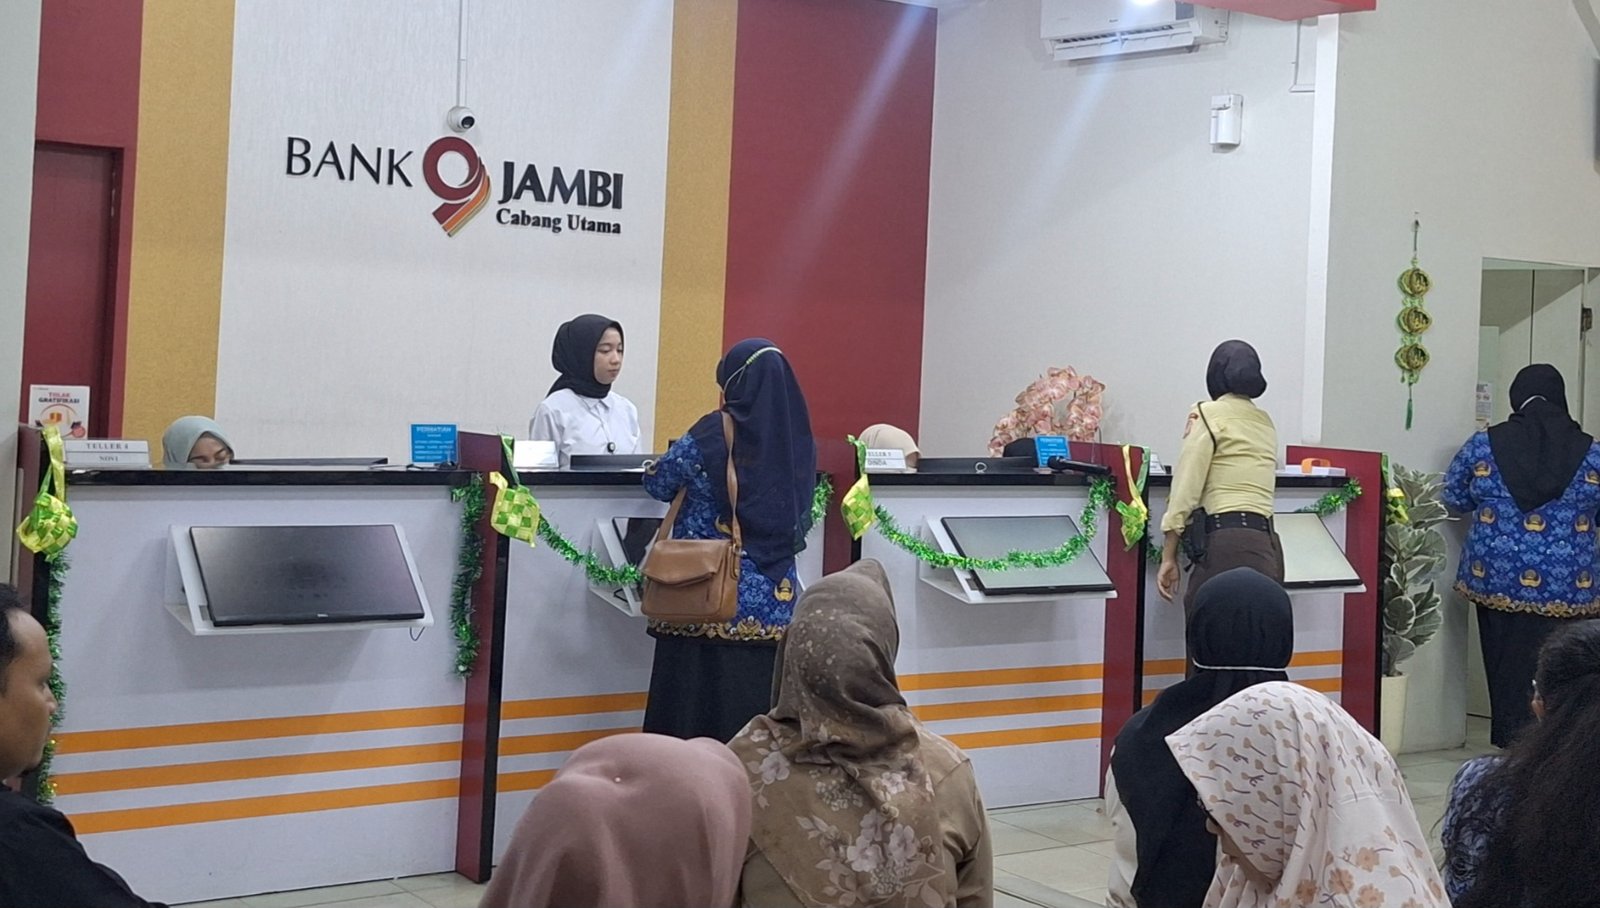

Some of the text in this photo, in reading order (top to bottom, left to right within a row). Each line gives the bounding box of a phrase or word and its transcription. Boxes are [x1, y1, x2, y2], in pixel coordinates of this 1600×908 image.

[286, 136, 413, 188] BANK
[497, 160, 624, 210] JAMBI
[496, 207, 622, 234] Cabang Utama
[86, 442, 122, 450] TELLER
